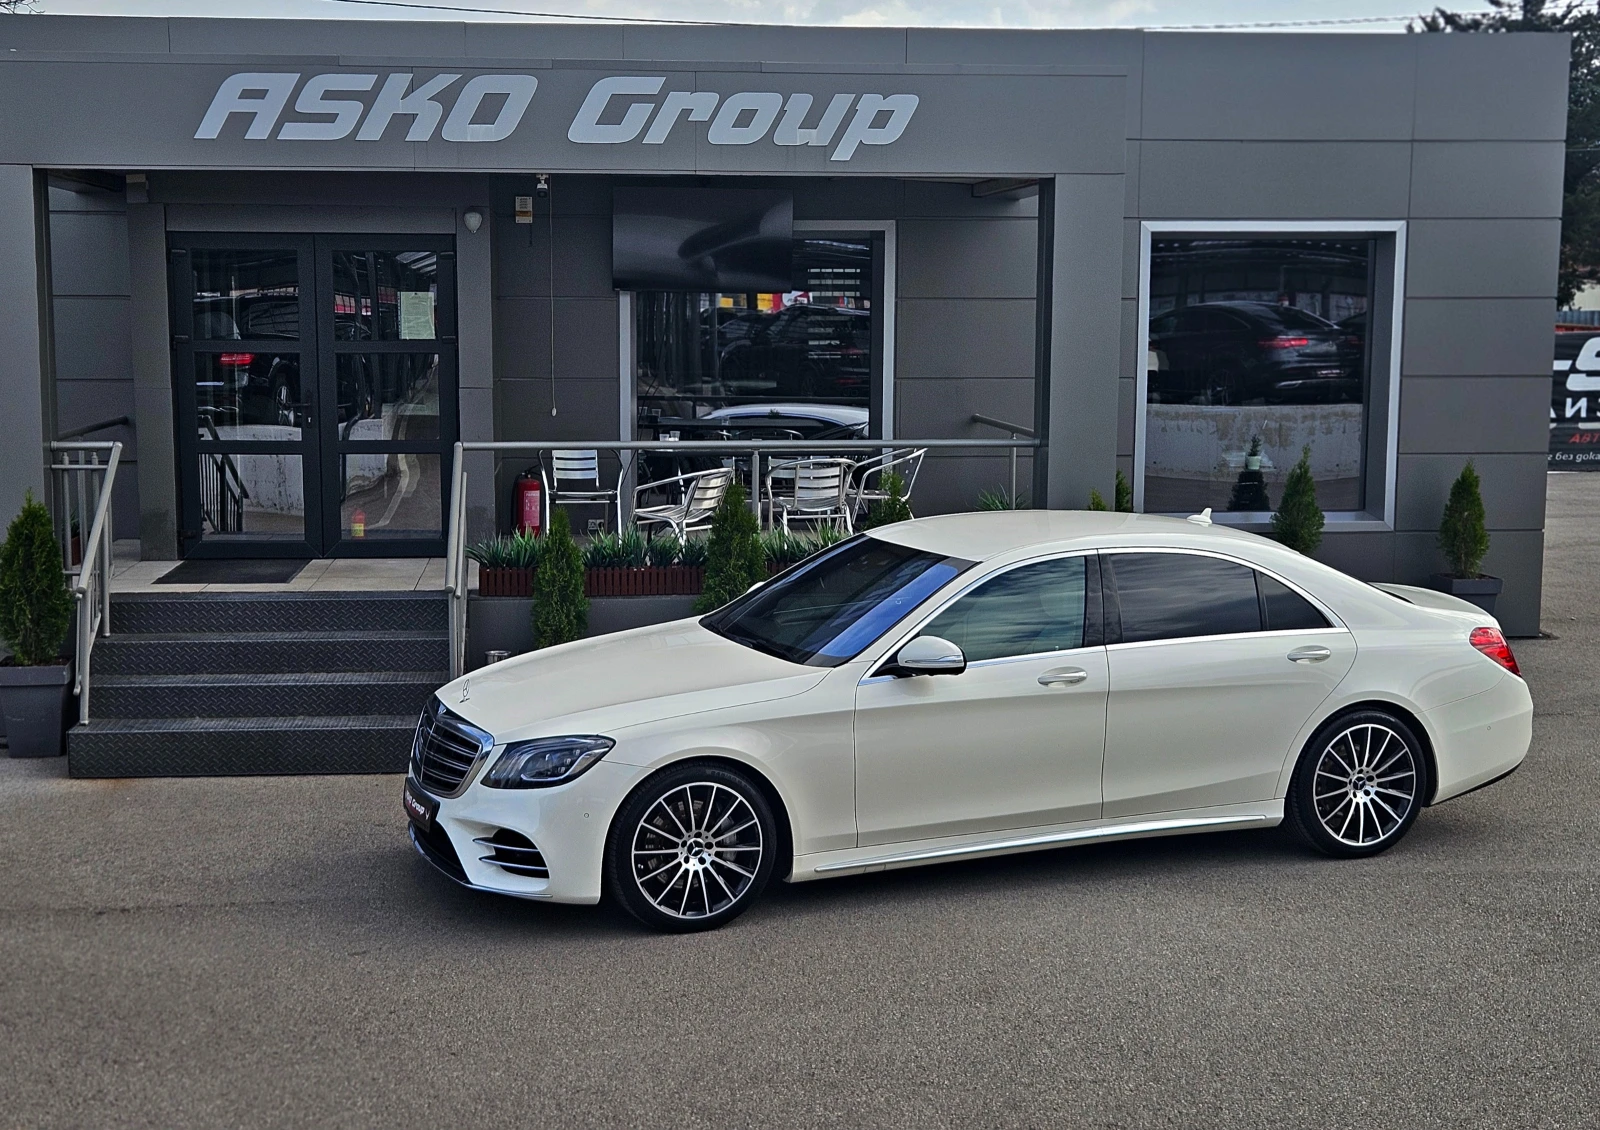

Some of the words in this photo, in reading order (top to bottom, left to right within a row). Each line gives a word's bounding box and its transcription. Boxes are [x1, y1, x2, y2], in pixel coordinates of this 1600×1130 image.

[193, 72, 538, 143] ASKO
[567, 75, 920, 161] Group
[1555, 451, 1574, 461] без
